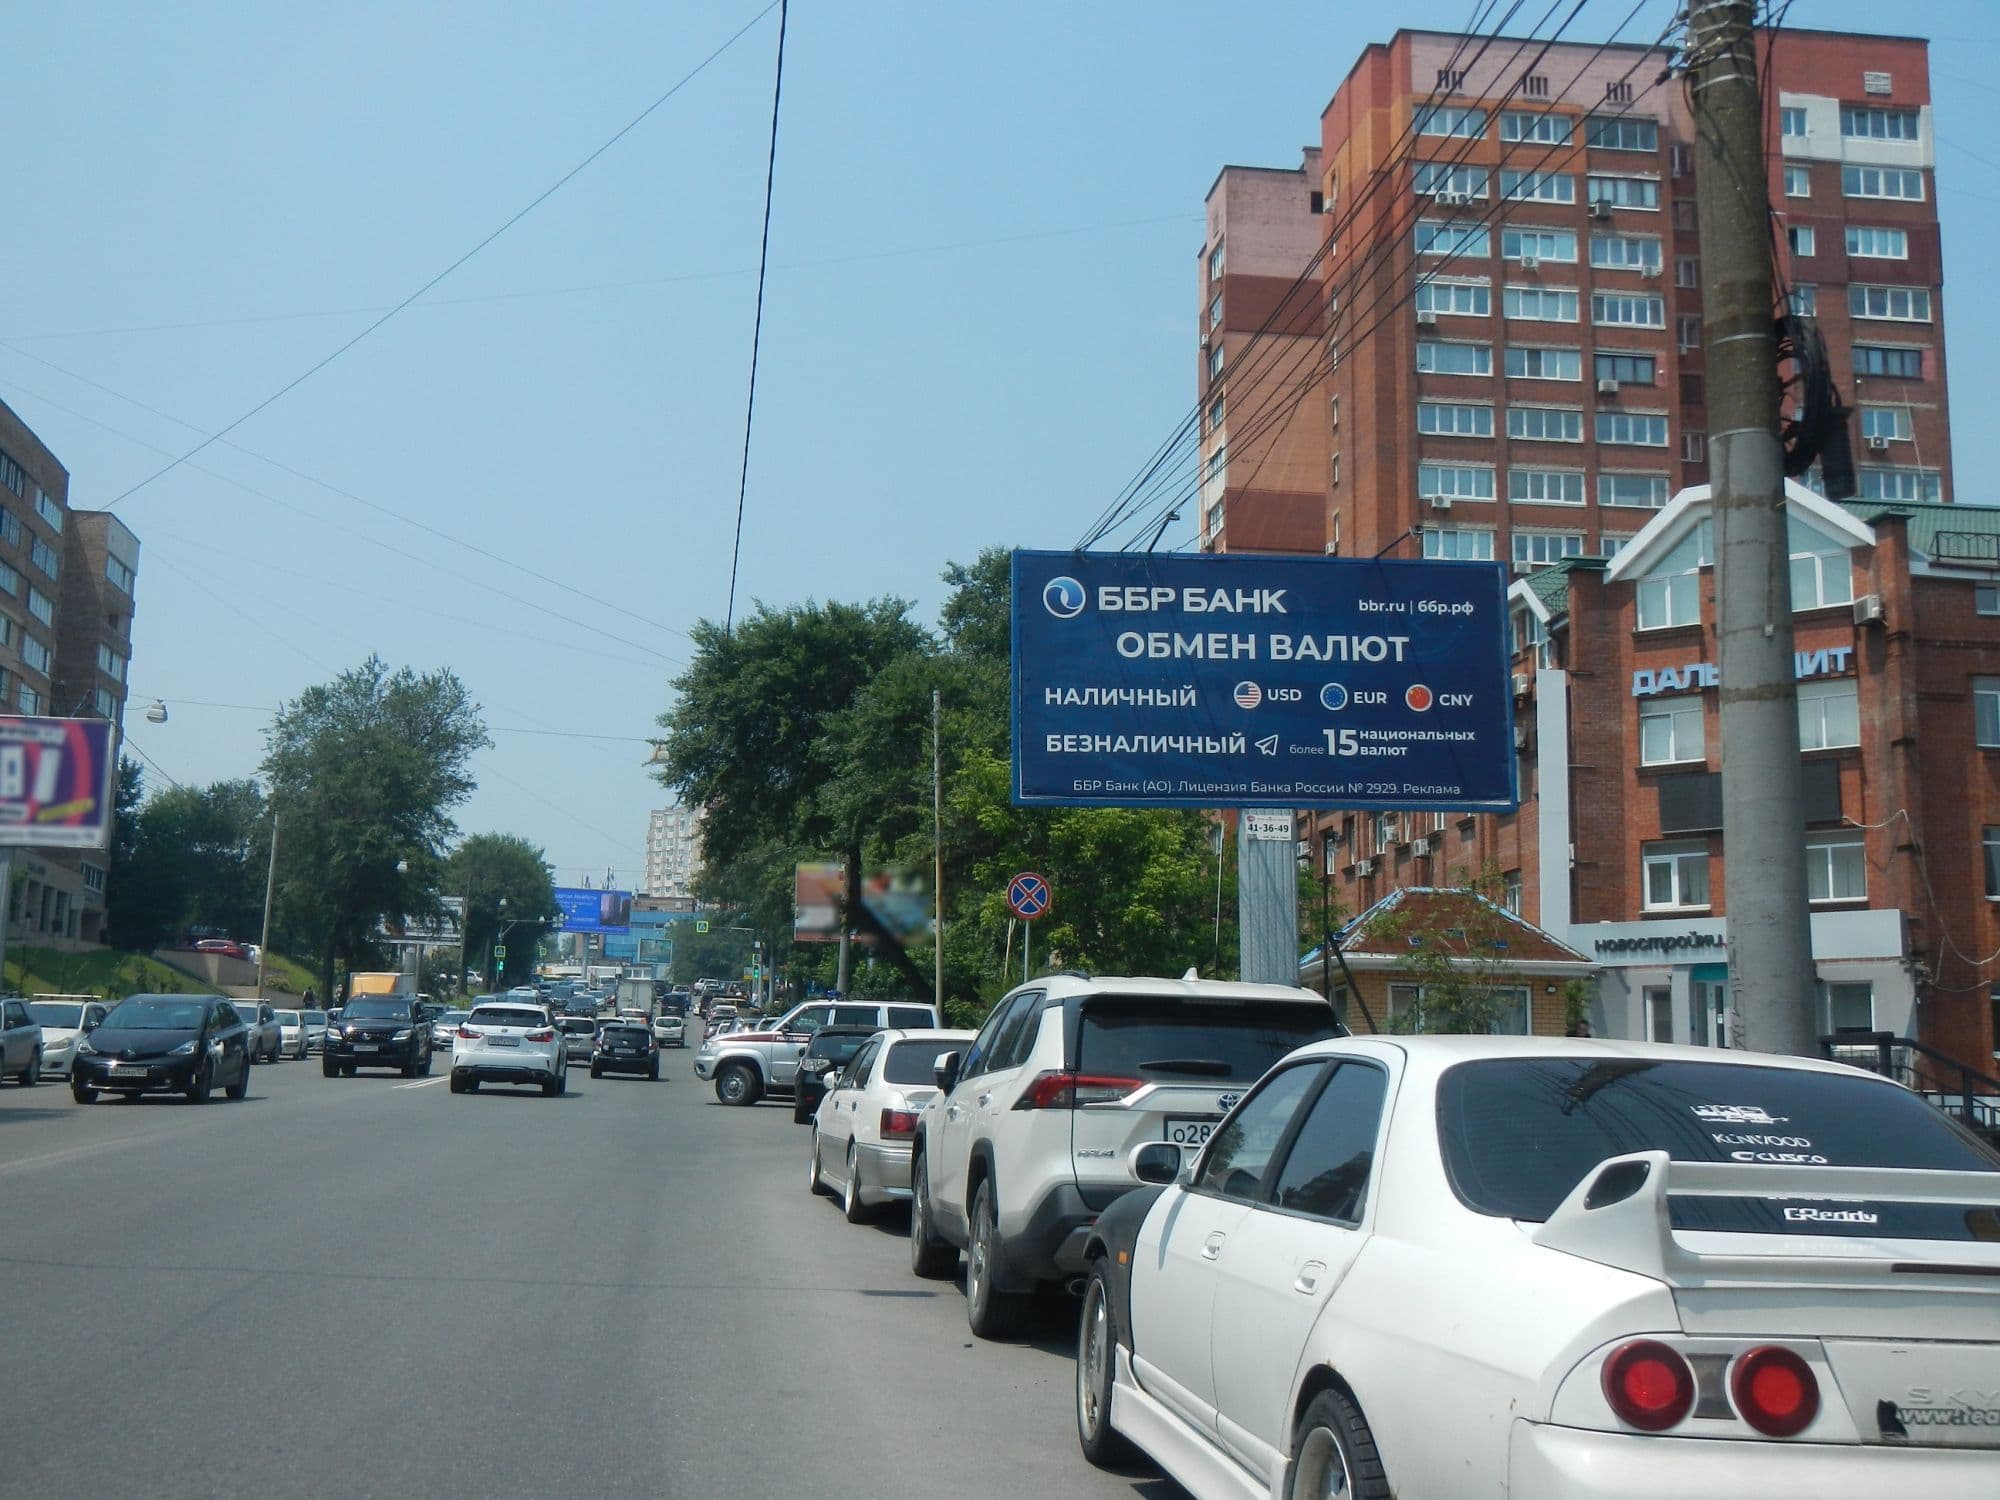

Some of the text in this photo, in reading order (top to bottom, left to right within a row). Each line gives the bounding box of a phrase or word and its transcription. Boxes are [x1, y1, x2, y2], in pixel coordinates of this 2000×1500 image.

[1098, 586, 1287, 613] ББР БАНК
[1358, 600, 1474, 616] bbr.ru ббр.рф
[1116, 631, 1409, 662] ОБМЕН ВАЛЮТ
[1045, 684, 1197, 707] НАЛИЧНЫЙ
[1267, 688, 1474, 706] USD EUR CNY
[1046, 732, 1246, 754] БЕЗНАЛИЧНЫЙ
[1289, 728, 1475, 756] более 15 национальных
[1360, 745, 1408, 757] валют
[1073, 780, 1101, 791] ББР
[1105, 780, 1139, 791] Банк
[1142, 780, 1176, 793] (АО).
[1178, 780, 1247, 794] Лицензия
[1251, 782, 1291, 793] Банка
[1295, 782, 1344, 794] России
[1366, 783, 1400, 794] 2929.
[1403, 783, 1461, 795] Реклама
[1247, 823, 1289, 833] 41-36-49
[1711, 1133, 1812, 1148] KENWOOD
